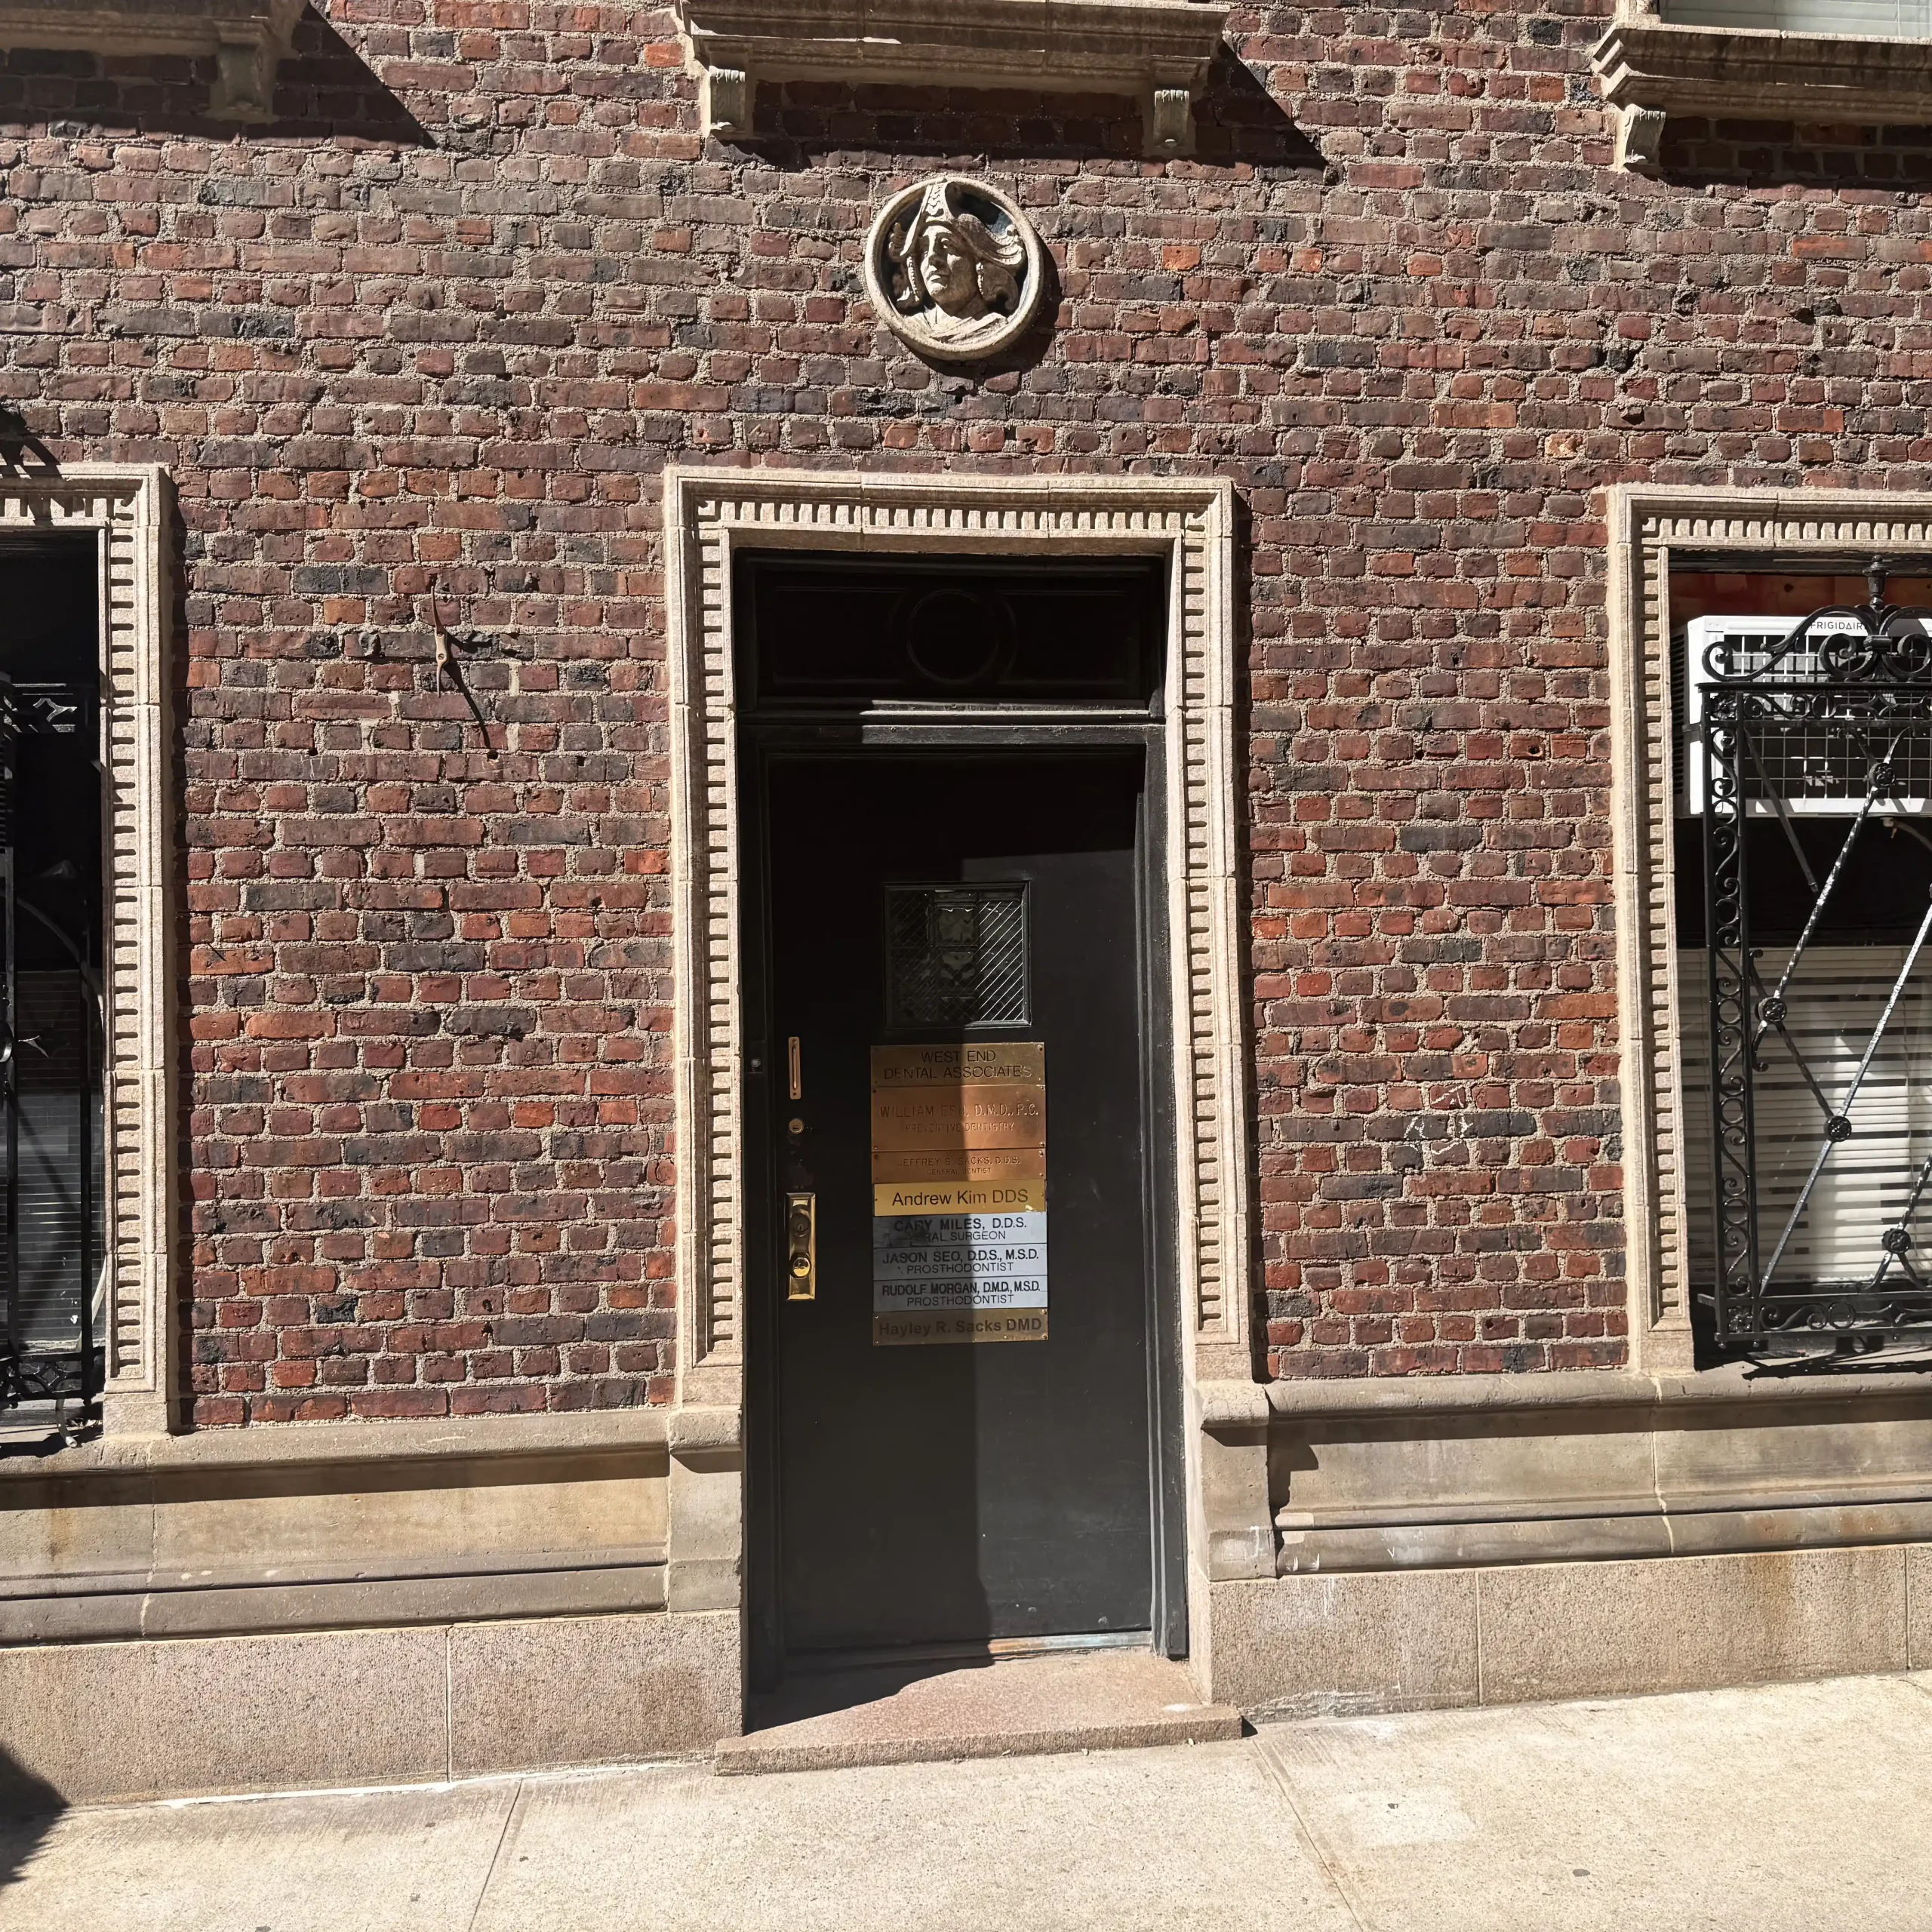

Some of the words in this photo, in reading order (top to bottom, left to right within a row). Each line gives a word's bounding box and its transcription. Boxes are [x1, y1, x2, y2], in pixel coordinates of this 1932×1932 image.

[1810, 621, 1866, 630] FRIGIDAIR
[921, 1051, 961, 1063] WEST
[968, 1050, 996, 1062] END
[884, 1067, 938, 1080] DENTAL
[943, 1065, 1032, 1078] ASSOCIATES
[880, 1105, 934, 1118] WILLIAM
[1017, 1103, 1039, 1116] P.C.
[964, 1121, 1014, 1131] DENTISTRY
[897, 1157, 940, 1167] JEFFREY
[995, 1155, 1021, 1164] D.D.S.
[892, 1192, 952, 1206] Andrew
[958, 1190, 986, 1204] Kim
[993, 1189, 1029, 1204] DDS
[894, 1219, 932, 1232] CARY
[940, 1218, 985, 1231] MILES,
[993, 1217, 1027, 1229] D.D.S.
[914, 1232, 944, 1242] RAL
[951, 1231, 1006, 1241] SURGEON
[882, 1252, 928, 1265] JASON
[933, 1251, 963, 1263] SEO,
[968, 1249, 1002, 1262] D.D.S.,
[1006, 1248, 1039, 1260] M.S.D.
[907, 1262, 1014, 1274] PROSTHODONTIST
[882, 1284, 927, 1296] RUDOLF
[931, 1282, 980, 1295] MORGAN,
[983, 1281, 1012, 1294] D.M.D.,
[1014, 1281, 1041, 1291] M.S.D.
[907, 1294, 1014, 1306] PROSTHODONTIST
[879, 1322, 931, 1337] Hayley
[936, 1321, 951, 1334] R.
[956, 1319, 1001, 1333] Sacks
[1006, 1318, 1041, 1331] DMD
